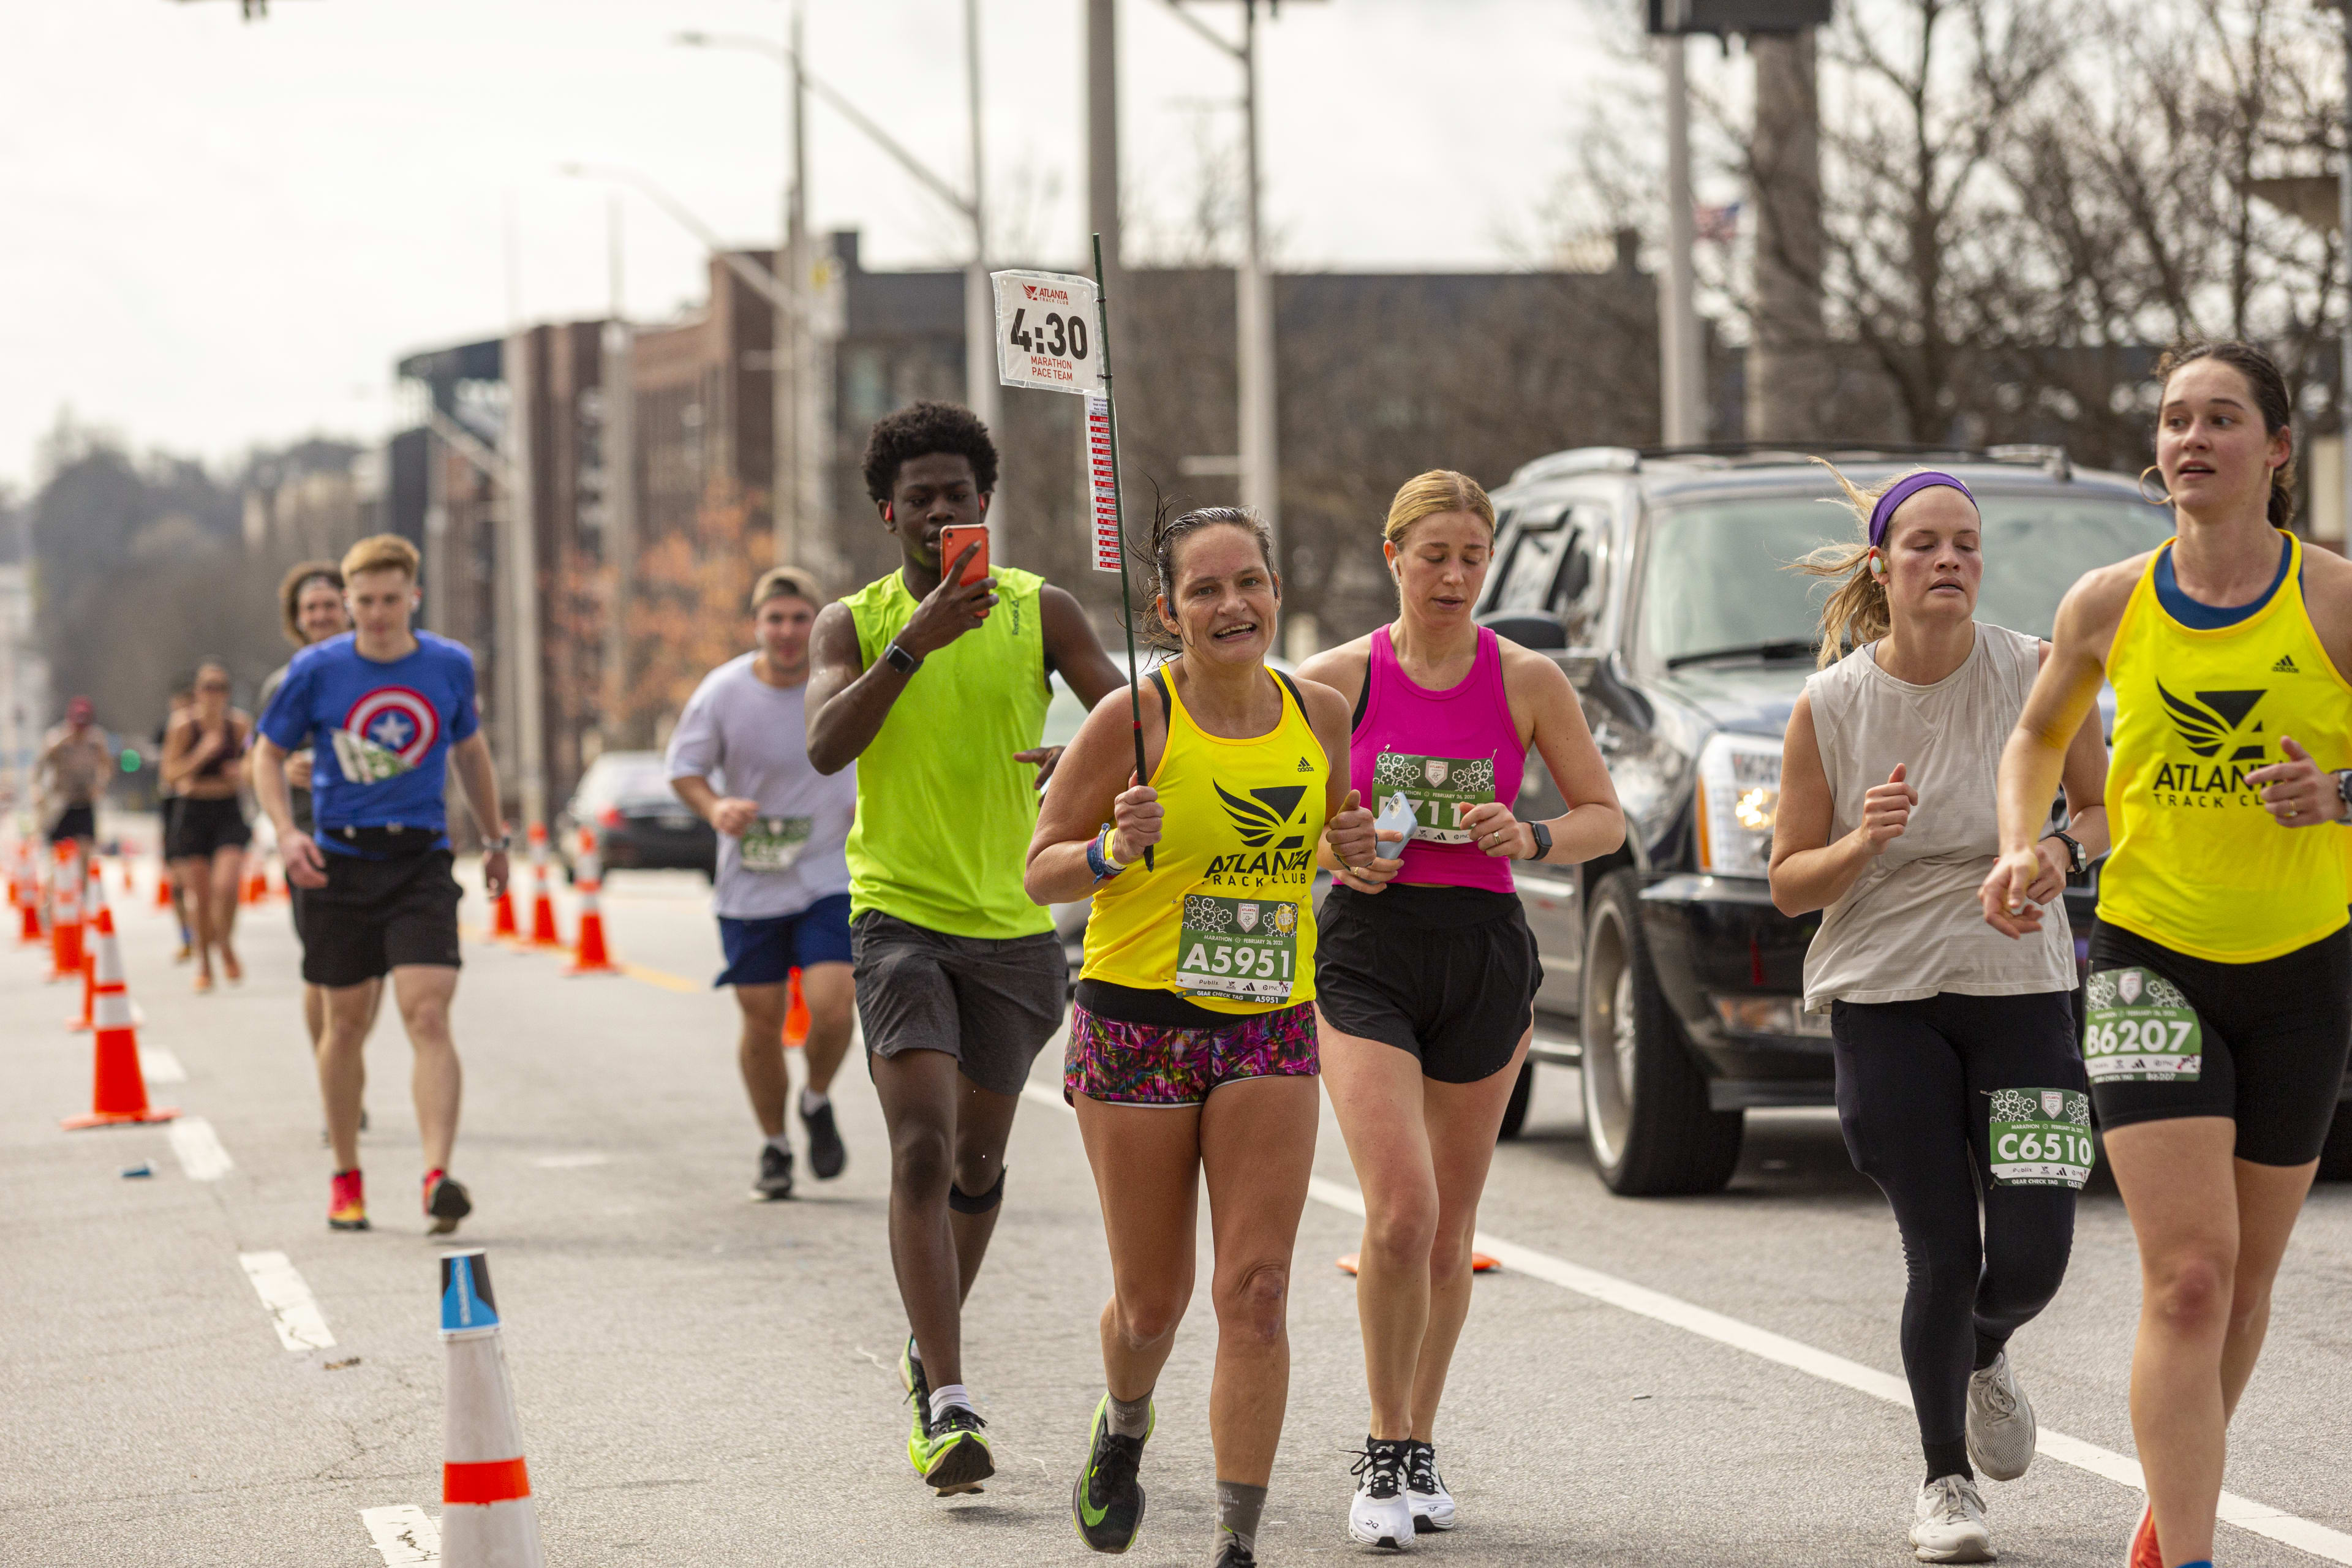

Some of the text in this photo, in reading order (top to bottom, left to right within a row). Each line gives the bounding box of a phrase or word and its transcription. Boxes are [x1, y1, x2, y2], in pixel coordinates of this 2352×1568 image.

[1039, 287, 1068, 300] ATLANTA
[1011, 308, 1088, 360] 4:30
[1031, 355, 1072, 370] MARATHON
[1032, 367, 1072, 381] PACE TEAM
[2152, 760, 2283, 793] ATLAN
[2154, 794, 2264, 808] TRACK CL
[1204, 850, 1313, 878] ATLANTA
[1202, 875, 1264, 887] RACK
[1182, 943, 1289, 978] A5951
[2086, 1019, 2193, 1056] B6207
[1997, 1133, 2092, 1166] C6510
